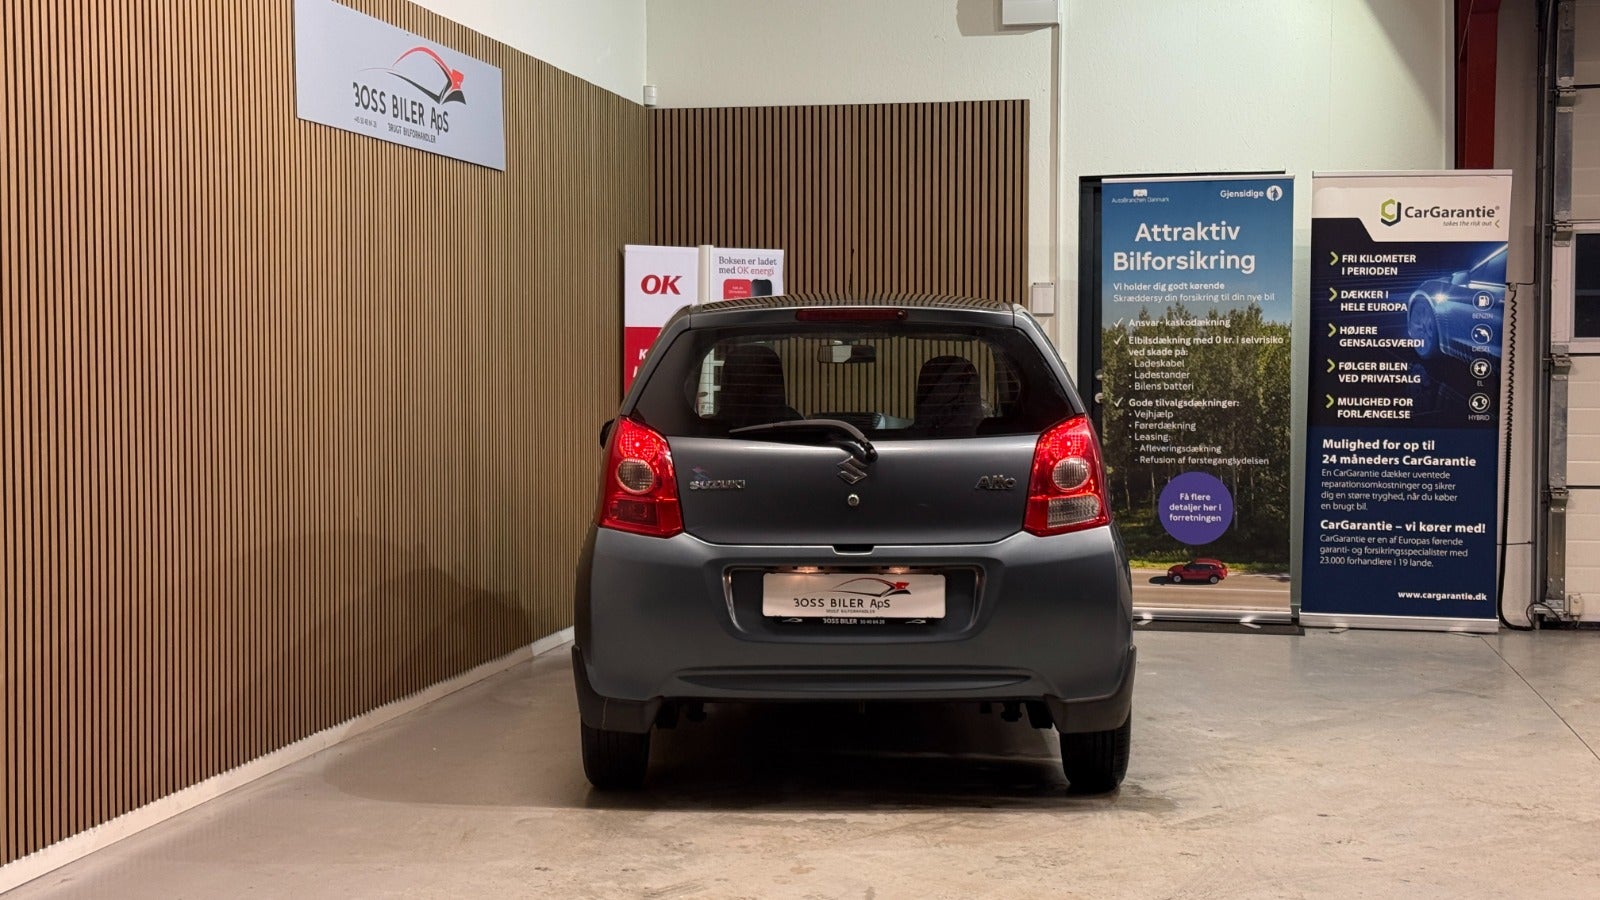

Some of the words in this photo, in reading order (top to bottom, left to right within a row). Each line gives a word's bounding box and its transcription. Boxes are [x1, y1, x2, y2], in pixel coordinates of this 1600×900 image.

[392, 95, 424, 126] BILER
[430, 107, 449, 135] ApS
[1220, 190, 1264, 198] Gjensidige
[1134, 221, 1240, 242] Attraktiv
[718, 256, 746, 265] Boksen
[1113, 250, 1256, 274] Bilforsikring
[1342, 255, 1357, 263] FRI
[1359, 255, 1417, 263] KILOMETER
[718, 266, 735, 274] med
[750, 267, 774, 277] energi
[1342, 267, 1345, 275] I
[1347, 267, 1398, 275] PERIODEN
[641, 274, 682, 295] OK
[1153, 283, 1166, 292] dig
[1168, 283, 1187, 292] godt
[1190, 282, 1224, 290] kørende
[1113, 294, 1162, 303] Skræddersy
[1165, 294, 1177, 302] din
[1179, 293, 1219, 303] forsikring
[1221, 293, 1231, 301] til
[1233, 293, 1245, 301] din
[1247, 294, 1262, 302] nye
[1264, 293, 1275, 301] bil
[1341, 291, 1383, 299] DÆKKER
[1385, 290, 1388, 299] I
[1340, 303, 1365, 311] HELE
[1367, 303, 1408, 312] EUROPA
[1129, 319, 1163, 327] Ansvar-
[1166, 318, 1231, 328] kaskodækning
[1340, 326, 1377, 334] HØJERE
[1129, 336, 1191, 346] Elbilsdækning
[1215, 336, 1221, 344] 0
[1223, 336, 1234, 344] kr.
[1241, 336, 1284, 344] selvrisiko
[1339, 339, 1424, 347] GENSALGSVÆRDI
[1129, 348, 1145, 356] ved
[1146, 348, 1173, 356] skade
[1175, 347, 1188, 358] på:
[1134, 360, 1185, 368] Ladeskabel
[1339, 362, 1377, 371] FØLGER
[1379, 362, 1408, 371] BILEN
[1134, 371, 1190, 379] Ladestander
[1338, 375, 1359, 383] VED
[1361, 375, 1421, 383] PRIVATSALG
[1134, 382, 1162, 390] Bilens
[1164, 382, 1194, 390] batteri
[1129, 399, 1153, 407] Gode
[1155, 399, 1240, 408] tilvalgsdækninger:
[1337, 398, 1390, 406] MULIGHED
[1393, 398, 1413, 406] FOR
[1134, 410, 1174, 419] Vejhjælp
[1337, 410, 1410, 419] FORLÆNGELSE
[1134, 422, 1196, 431] Førerdækning
[1134, 433, 1171, 442] Leasing:
[1140, 444, 1222, 454] Afleveringsdækning
[1322, 439, 1380, 451] Mulighed
[1383, 440, 1400, 449] for
[1403, 442, 1419, 452] op
[1422, 440, 1435, 450] til
[1140, 456, 1176, 464] Refusion
[1178, 456, 1186, 464] af
[1187, 456, 1269, 466] førstegangsydelsen
[1322, 454, 1337, 464] 24
[1340, 454, 1400, 465] måneders
[1402, 455, 1477, 466] CarGarantie
[1321, 469, 1332, 477] En
[1333, 469, 1379, 478] CarGarantie
[1381, 470, 1410, 478] dækker
[1412, 471, 1451, 479] uventede
[690, 480, 745, 489] SUZUKI
[1321, 480, 1420, 490] reparationsomkostninger
[1422, 483, 1433, 491] og
[1434, 482, 1456, 490] sikrer
[1321, 491, 1334, 500] dig
[1347, 492, 1370, 500] større
[1372, 492, 1405, 502] tryghed,
[1422, 493, 1433, 501] du
[1434, 493, 1457, 502] køber
[1169, 504, 1201, 512] detaljer
[1333, 502, 1355, 511] brugt
[1169, 514, 1221, 523] forretningen
[1320, 519, 1392, 531] CarGarantie
[1405, 522, 1416, 531] vi
[1419, 522, 1452, 532] kører
[1455, 522, 1486, 533] med!
[1320, 535, 1365, 543] CarGarantie
[1398, 537, 1430, 546] Europas
[1431, 537, 1463, 546] førende
[1320, 546, 1349, 555] garanti-
[1352, 548, 1362, 557] og
[1364, 546, 1447, 557] forsikringsspecialister
[1450, 549, 1468, 557] med
[1347, 557, 1392, 566] forhandlere
[1399, 558, 1408, 566] 19
[1410, 559, 1434, 567] lande.
[1398, 591, 1487, 601] www.cargarantie.dk
[830, 598, 863, 608] BILER
[870, 599, 891, 610] ApS
